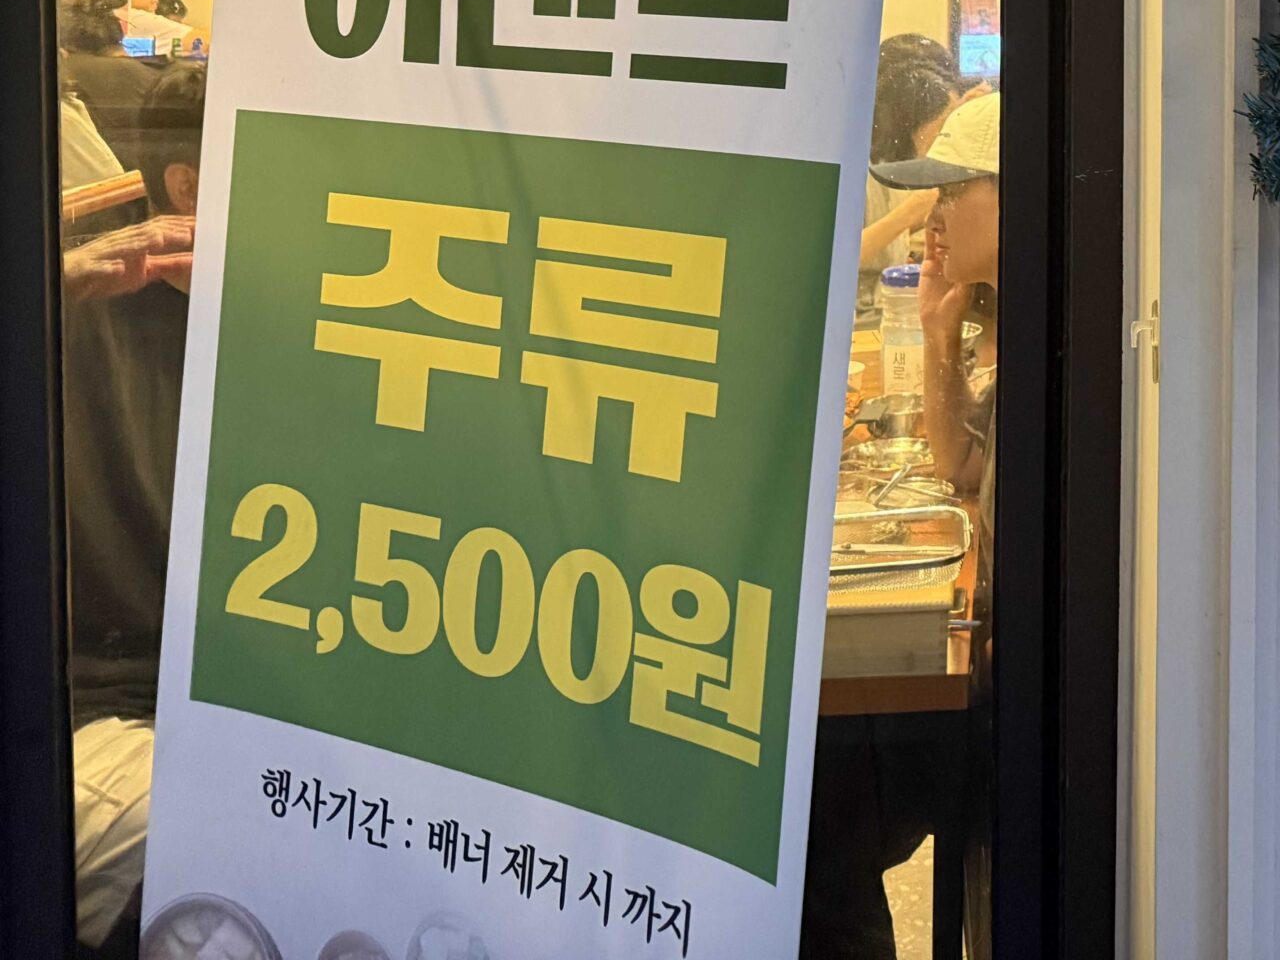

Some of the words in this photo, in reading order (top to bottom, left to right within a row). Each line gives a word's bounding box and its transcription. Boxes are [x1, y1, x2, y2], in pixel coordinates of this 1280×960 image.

[313, 191, 728, 483] 주류
[893, 352, 906, 380] 새로
[225, 483, 773, 768] 2,500원
[261, 768, 395, 849] 행사기간
[427, 818, 491, 884] 배너
[502, 844, 570, 910] 제거
[579, 870, 612, 927] 시
[621, 885, 692, 959] 까지
